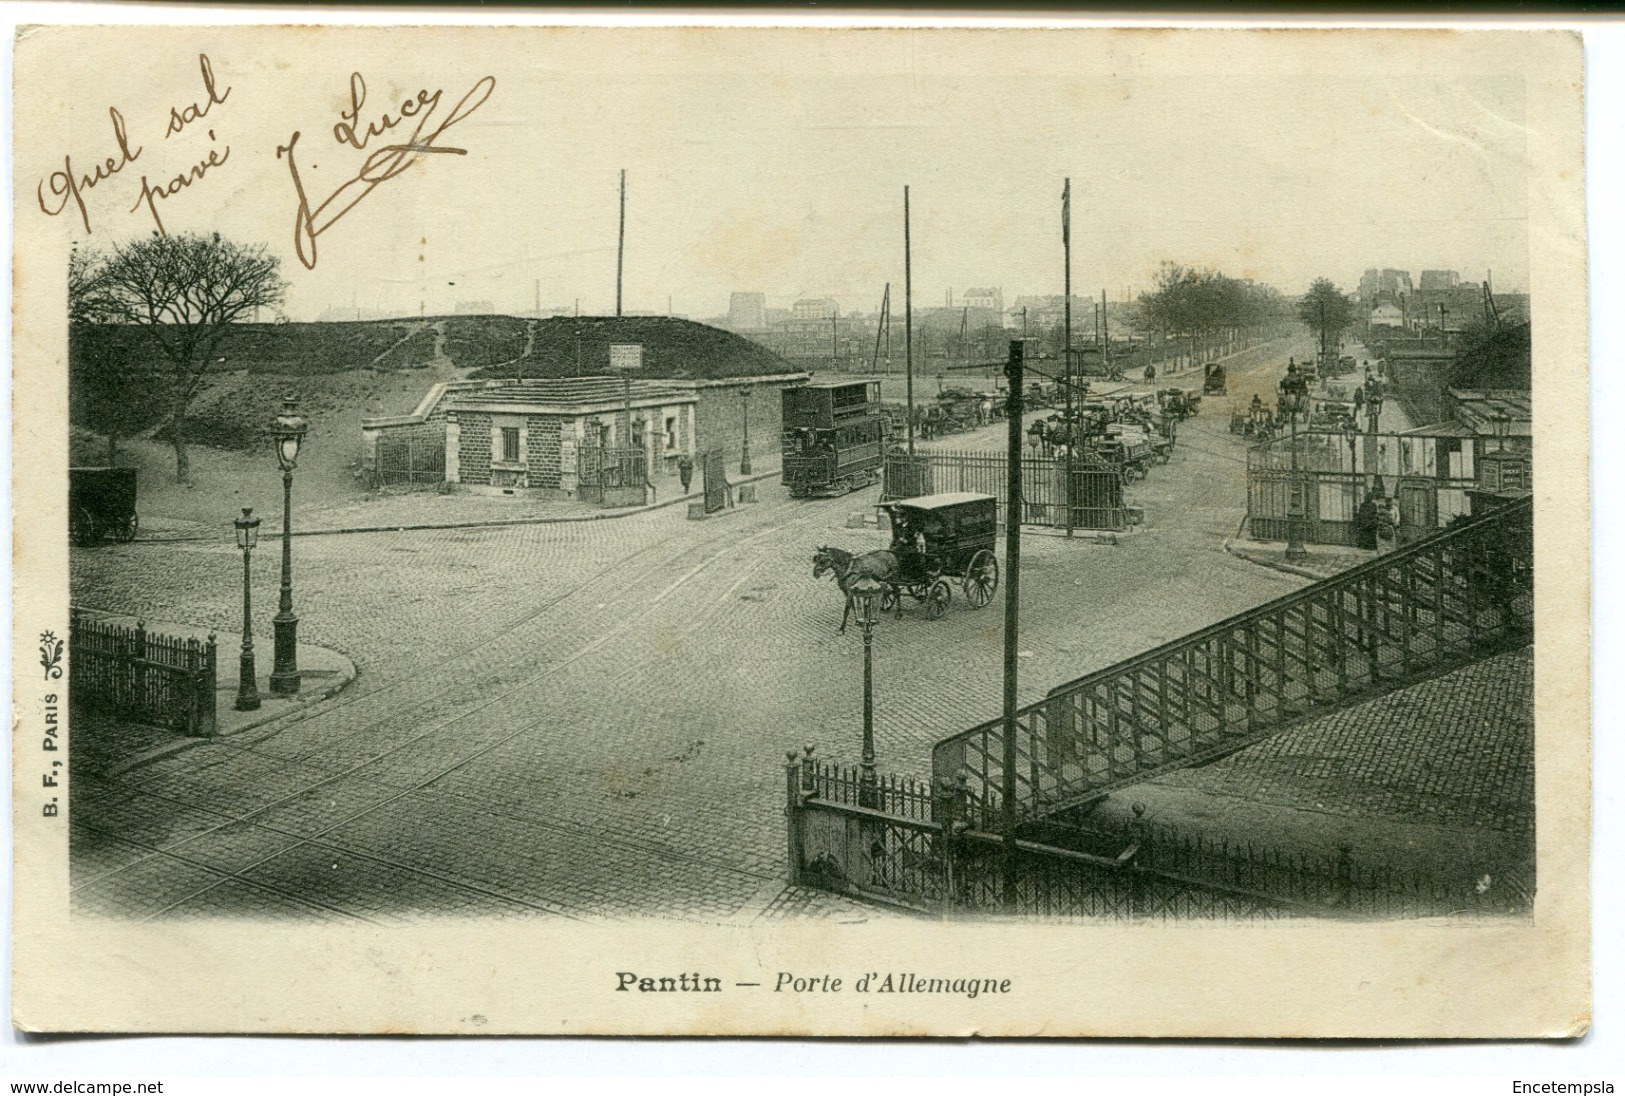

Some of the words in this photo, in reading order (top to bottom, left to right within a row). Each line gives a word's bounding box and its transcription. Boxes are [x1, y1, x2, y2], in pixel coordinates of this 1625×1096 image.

[38, 106, 143, 234] Quel
[165, 53, 232, 140] sal
[130, 130, 231, 239] pavé
[42, 693, 58, 752] PARIS
[42, 760, 63, 788] F.,
[42, 797, 58, 818] B.
[615, 972, 723, 993] Pantin
[774, 972, 843, 993] Porte
[855, 972, 1012, 999] d'Allemagne
